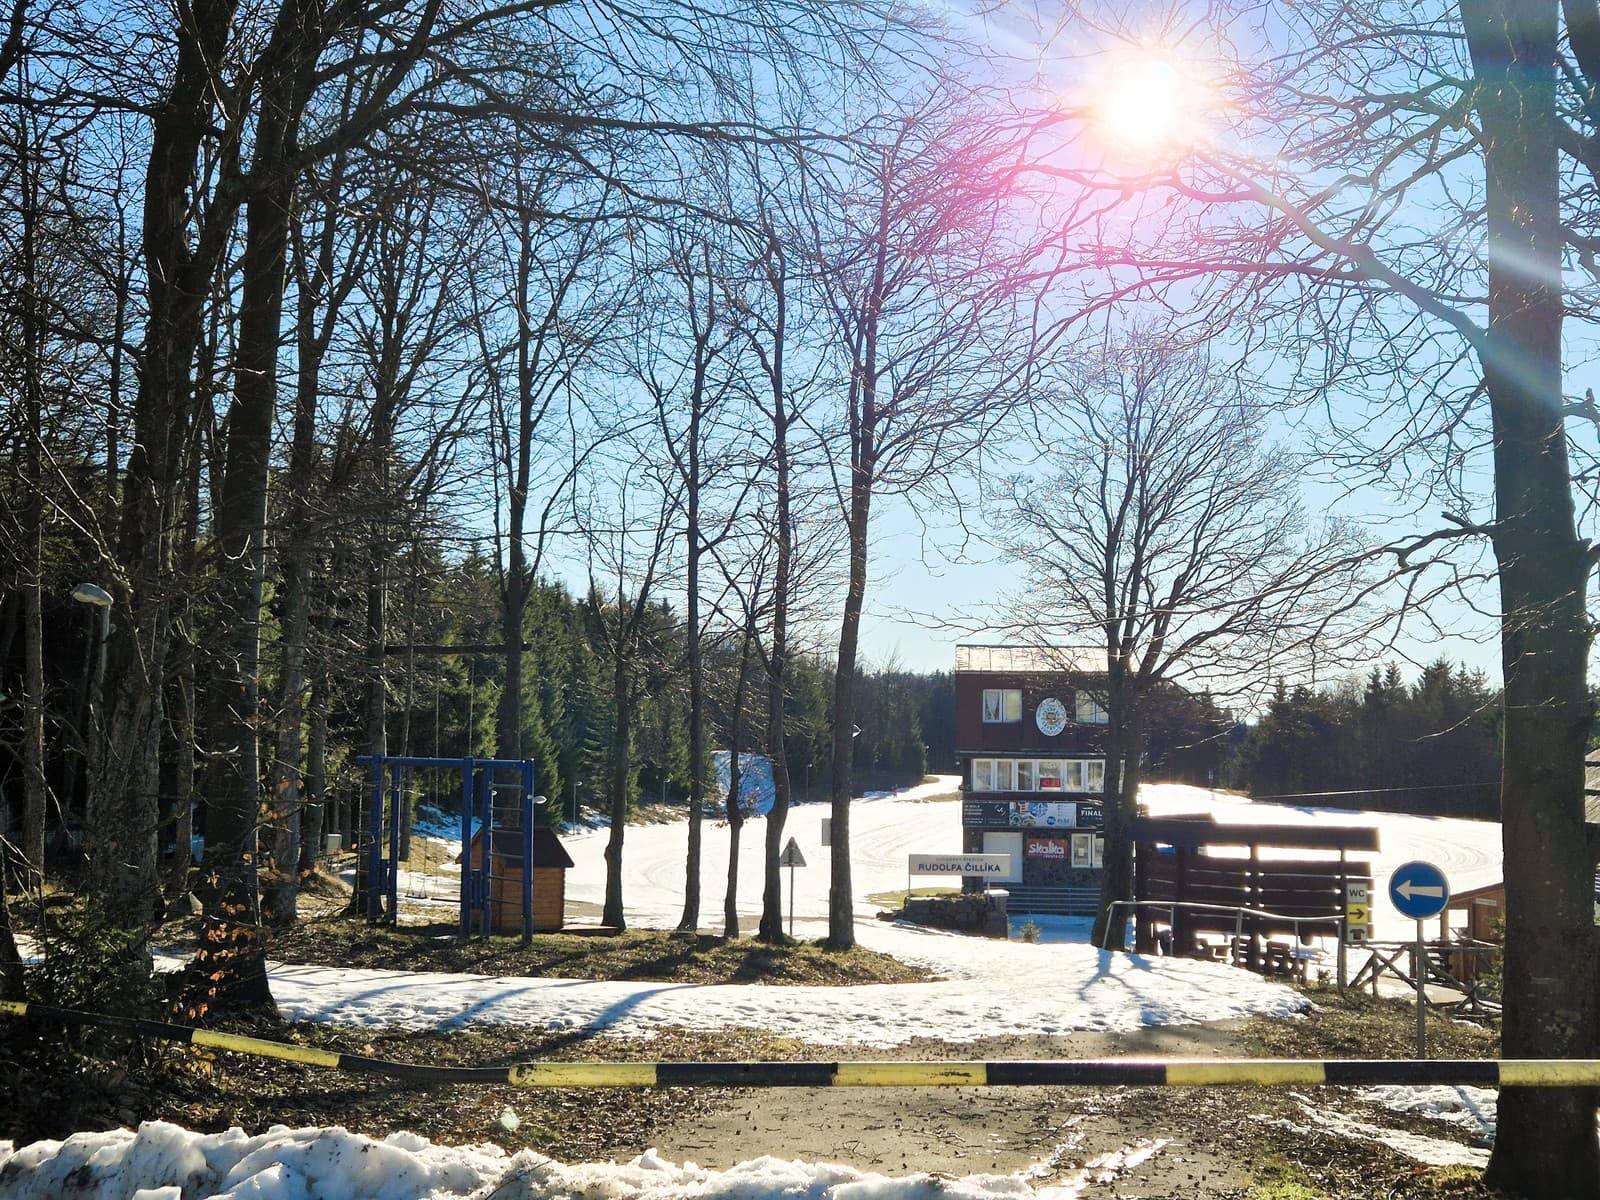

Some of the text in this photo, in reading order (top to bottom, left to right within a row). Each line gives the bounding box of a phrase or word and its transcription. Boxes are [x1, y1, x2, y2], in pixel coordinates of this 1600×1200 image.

[1028, 840, 1064, 855] Skalka
[918, 863, 962, 872] RUDOLFA
[1348, 889, 1365, 897] WC
